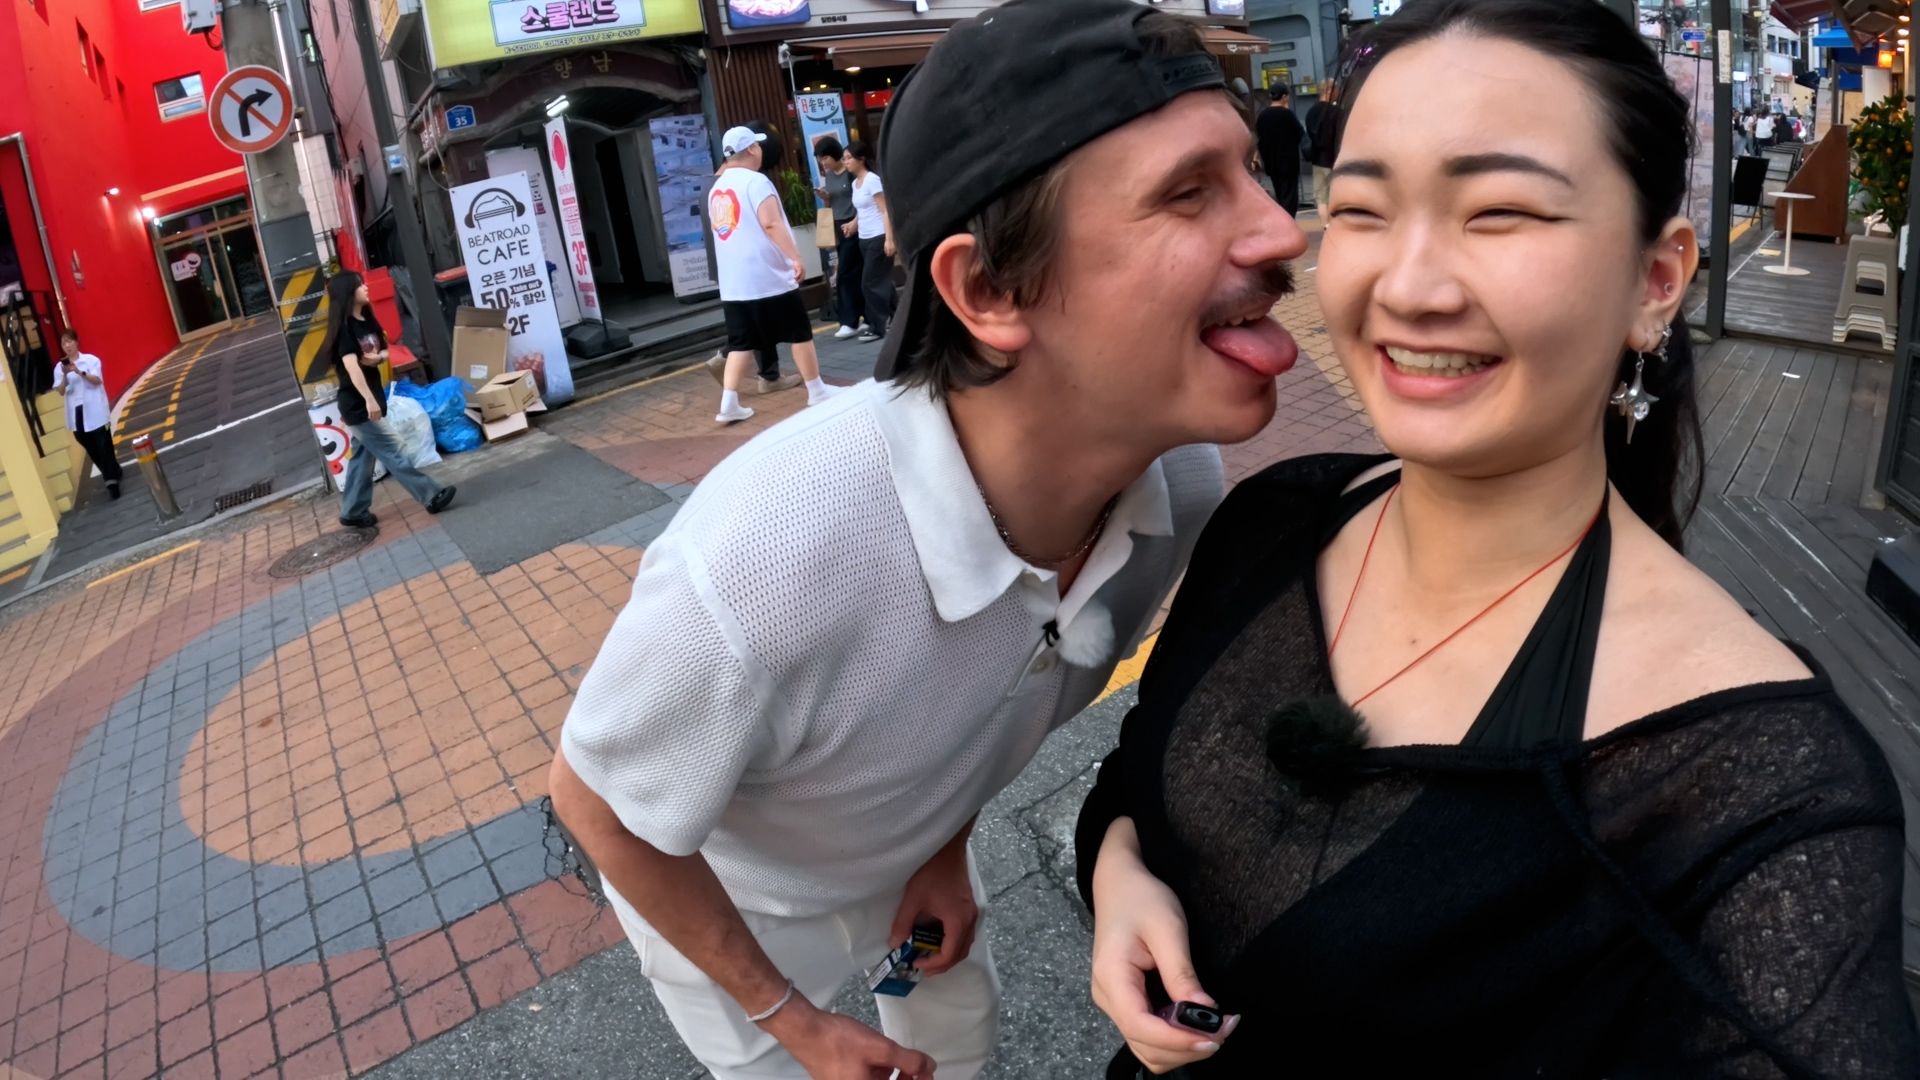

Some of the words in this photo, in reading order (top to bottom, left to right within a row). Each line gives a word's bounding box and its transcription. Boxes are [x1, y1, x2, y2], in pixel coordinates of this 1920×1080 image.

[520, 0, 620, 33] 스쿨랜드
[455, 116, 467, 127] 35
[468, 224, 530, 248] BEATROAD
[477, 239, 530, 265] CAFE
[572, 241, 587, 276] 3F
[481, 270, 507, 288] 오픈
[510, 263, 536, 280] 기념
[523, 290, 546, 306] 할인
[508, 314, 530, 336] 2F
